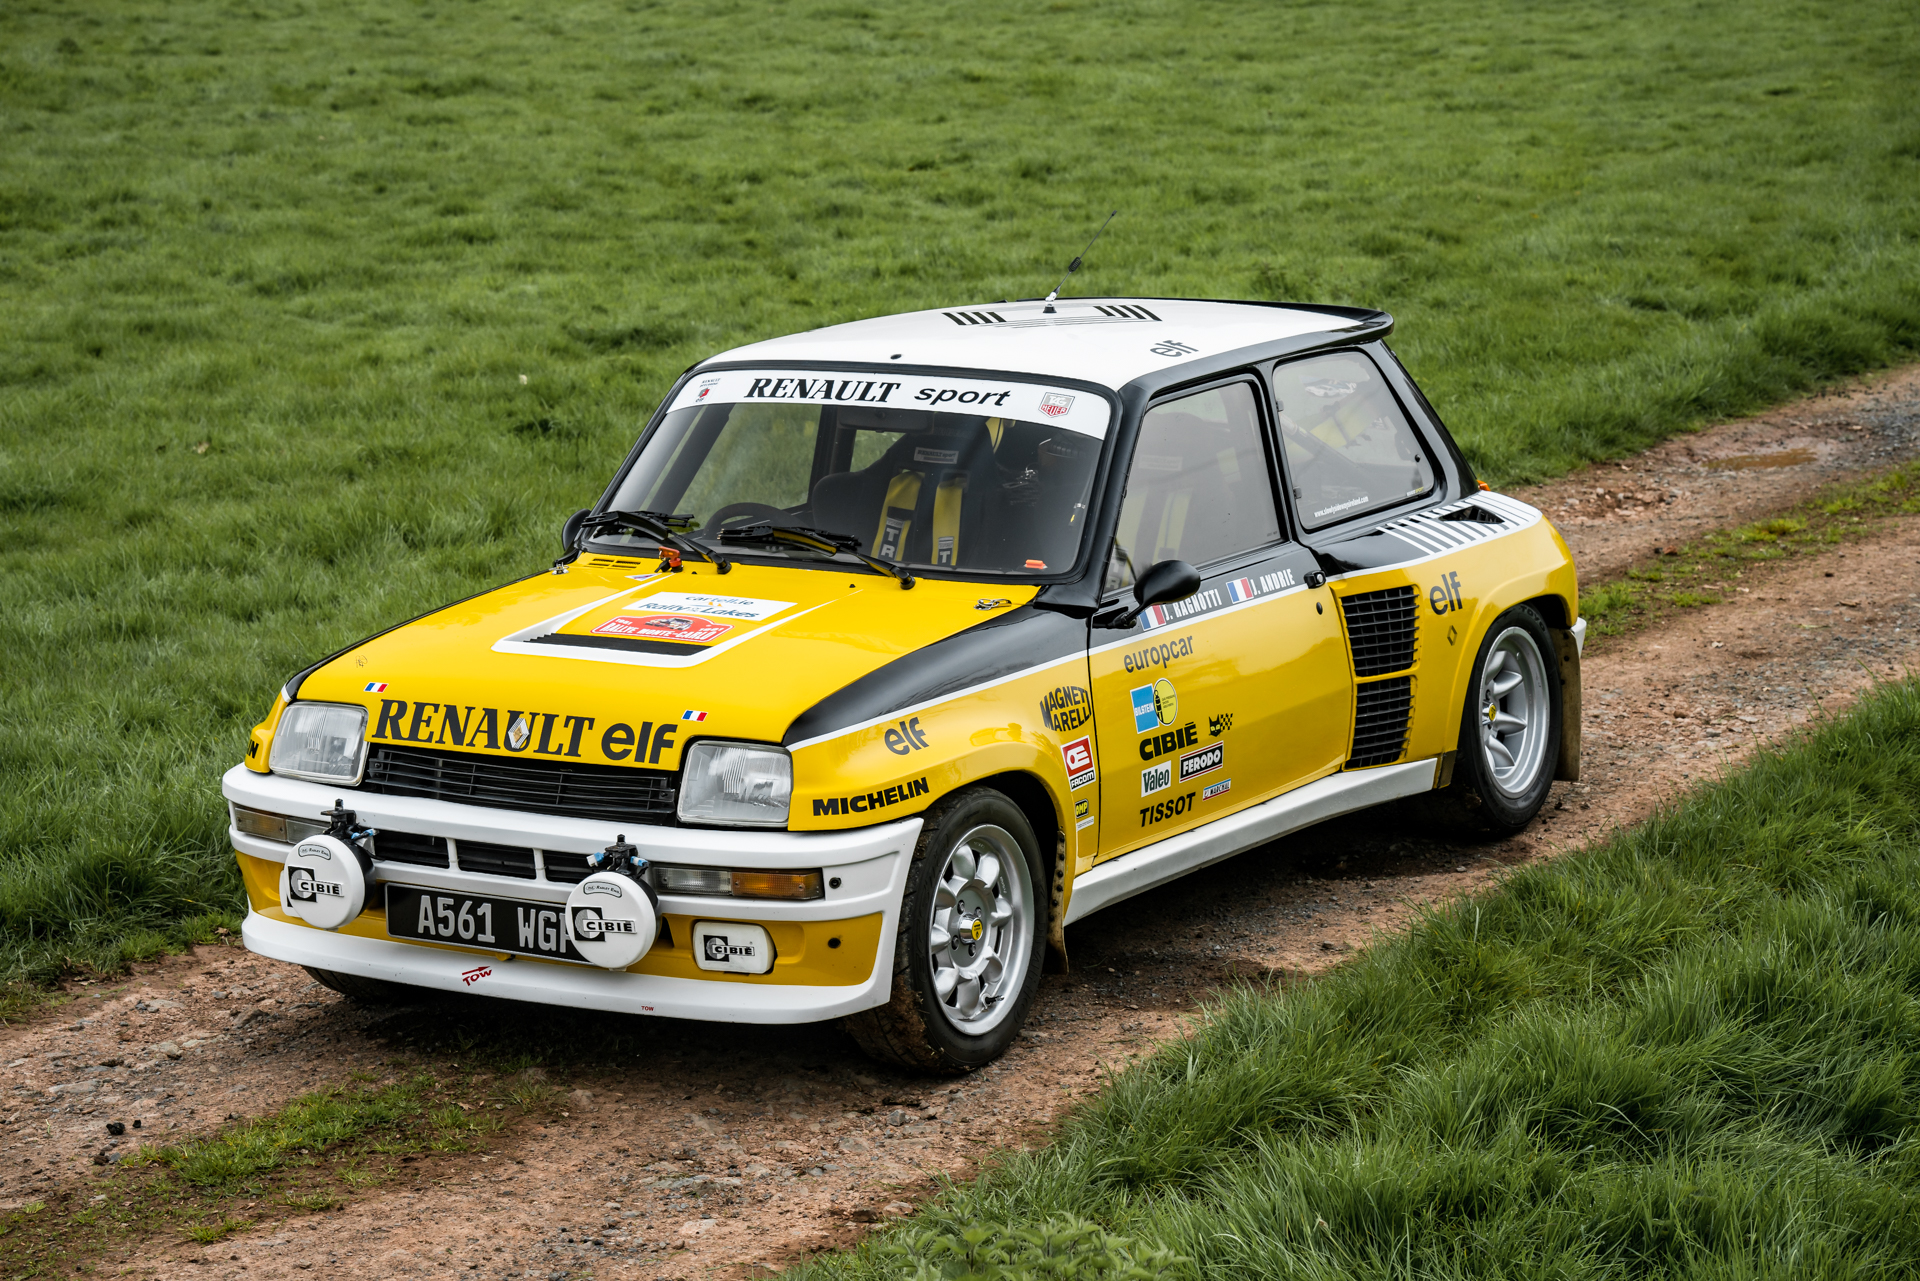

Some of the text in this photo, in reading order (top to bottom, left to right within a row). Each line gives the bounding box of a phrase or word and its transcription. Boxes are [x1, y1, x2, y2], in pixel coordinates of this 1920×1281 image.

[1150, 340, 1199, 357] elf
[743, 378, 1011, 406] RENAULT sport
[1049, 396, 1068, 405] TAG
[1041, 404, 1067, 416] HEUER
[1260, 569, 1295, 593] ANDRIE
[1429, 571, 1463, 615] elf
[638, 602, 688, 612] Rally
[700, 607, 759, 617] Lakes
[686, 596, 754, 605] cartell.ie
[1173, 589, 1222, 618] RAGNOTTI
[599, 622, 639, 633] RALLYE
[1520, 605, 1546, 632] TOYO
[1124, 635, 1193, 673] europcar
[1134, 702, 1154, 717] BILSTEIN
[372, 699, 678, 764] RENAULT elf
[884, 717, 929, 755] elf
[1182, 749, 1221, 775] FERODO
[1143, 769, 1170, 793] Valeo
[813, 777, 929, 816] MICHELIN
[1140, 792, 1196, 827] TISSOT
[417, 895, 495, 943] A561
[462, 969, 492, 987] TOW
